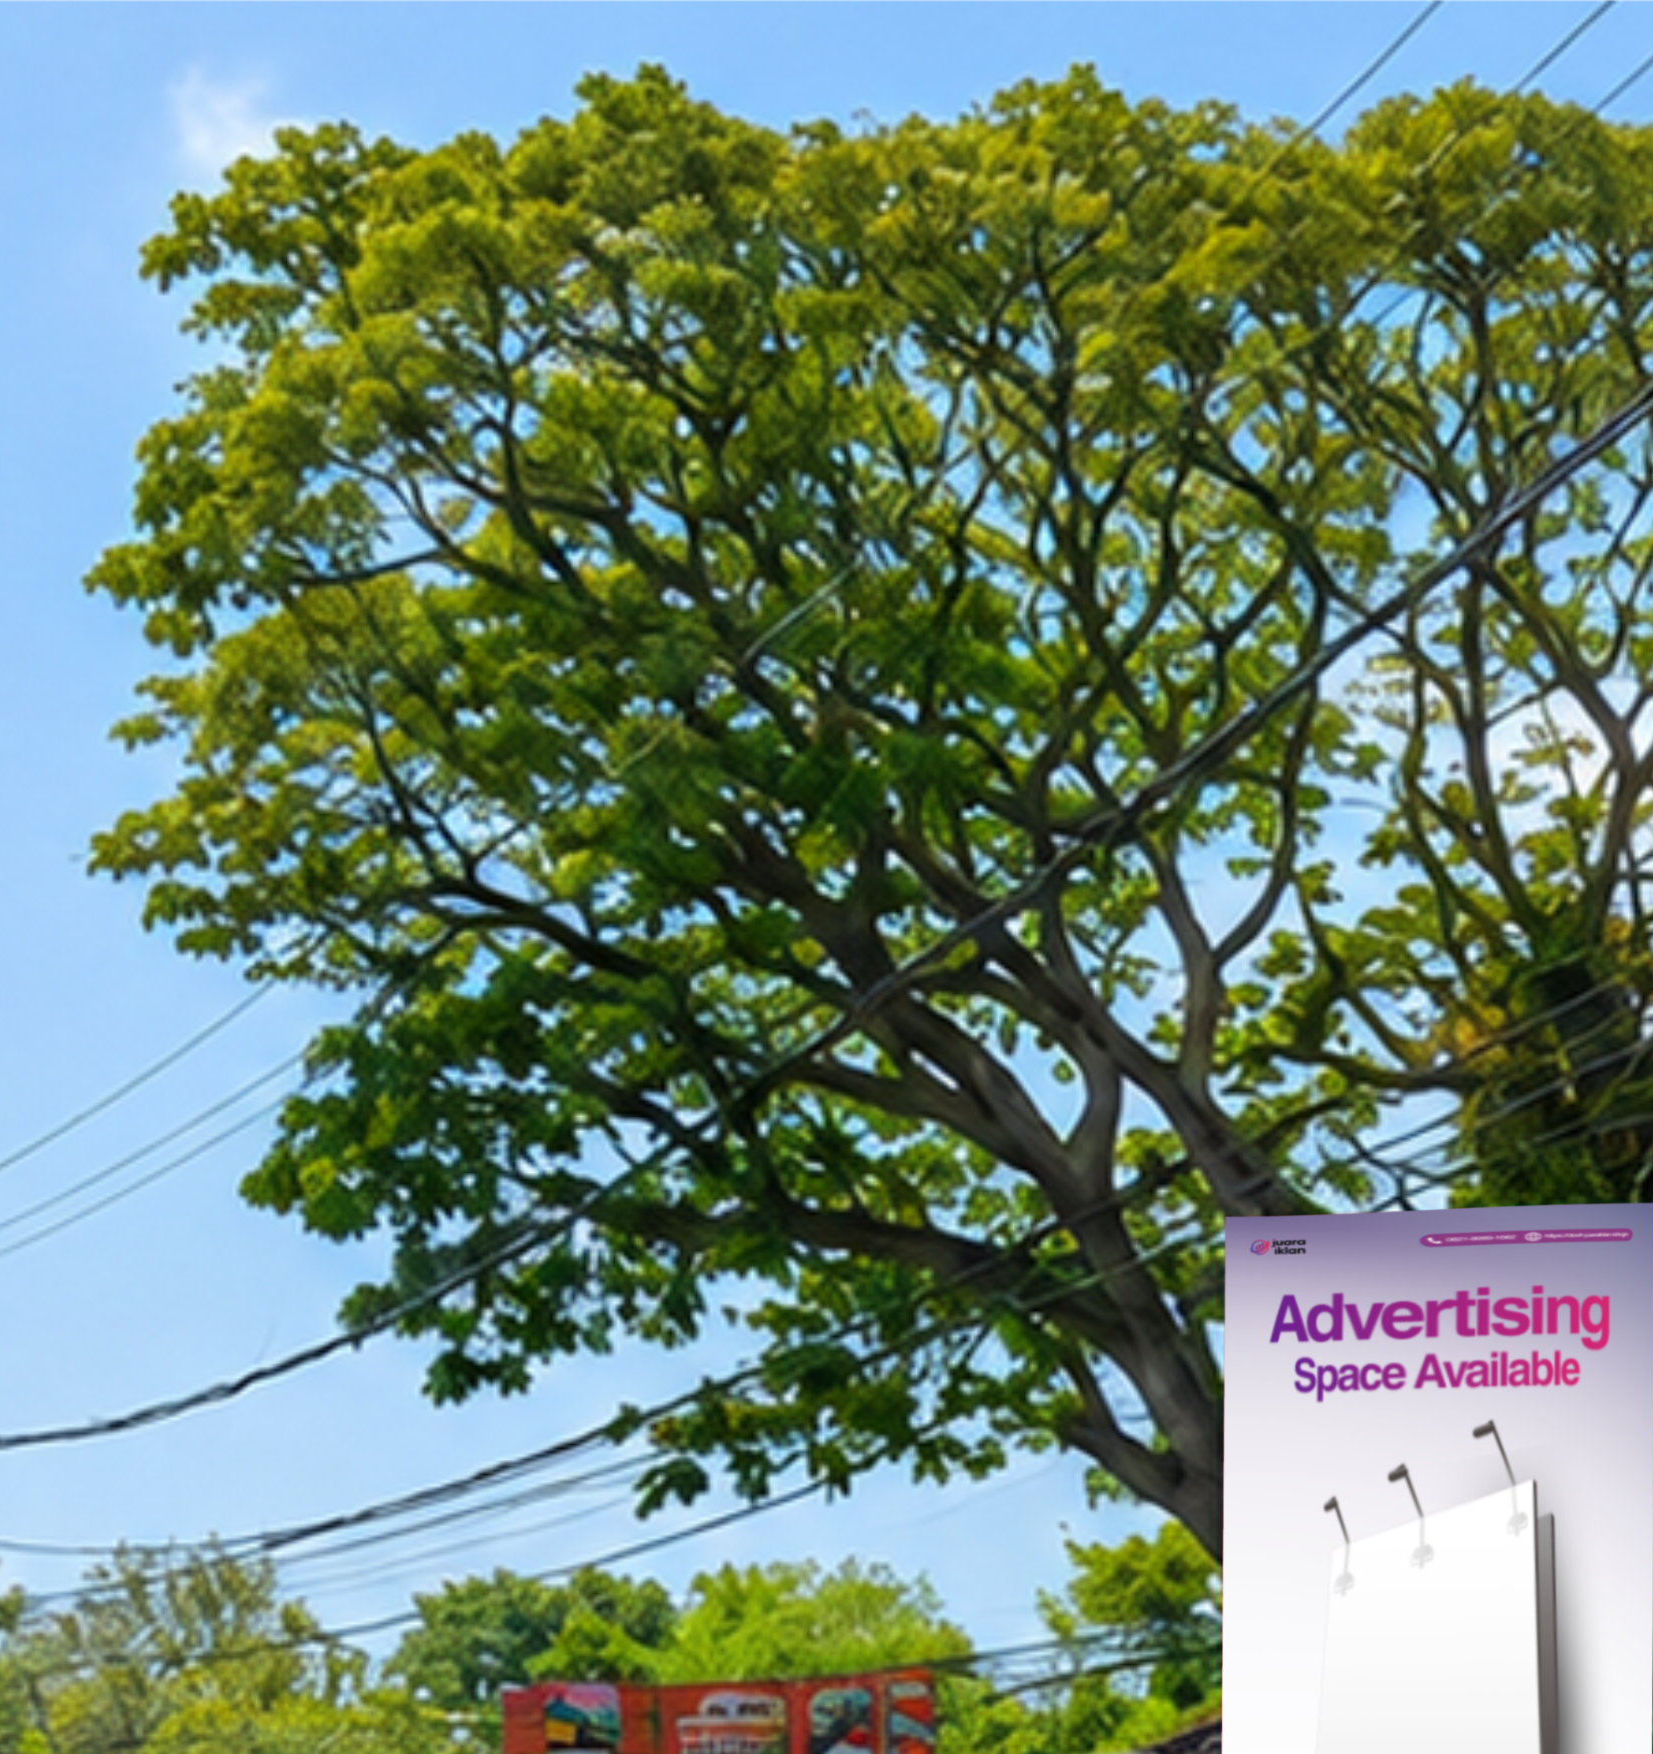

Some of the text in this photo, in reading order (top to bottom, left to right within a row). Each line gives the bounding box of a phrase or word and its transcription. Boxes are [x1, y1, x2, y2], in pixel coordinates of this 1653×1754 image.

[1272, 1239, 1306, 1248] juara
[1274, 1246, 1306, 1255] iklan
[1270, 1286, 1611, 1350] Advertising
[1294, 1350, 1581, 1402] Space Available
